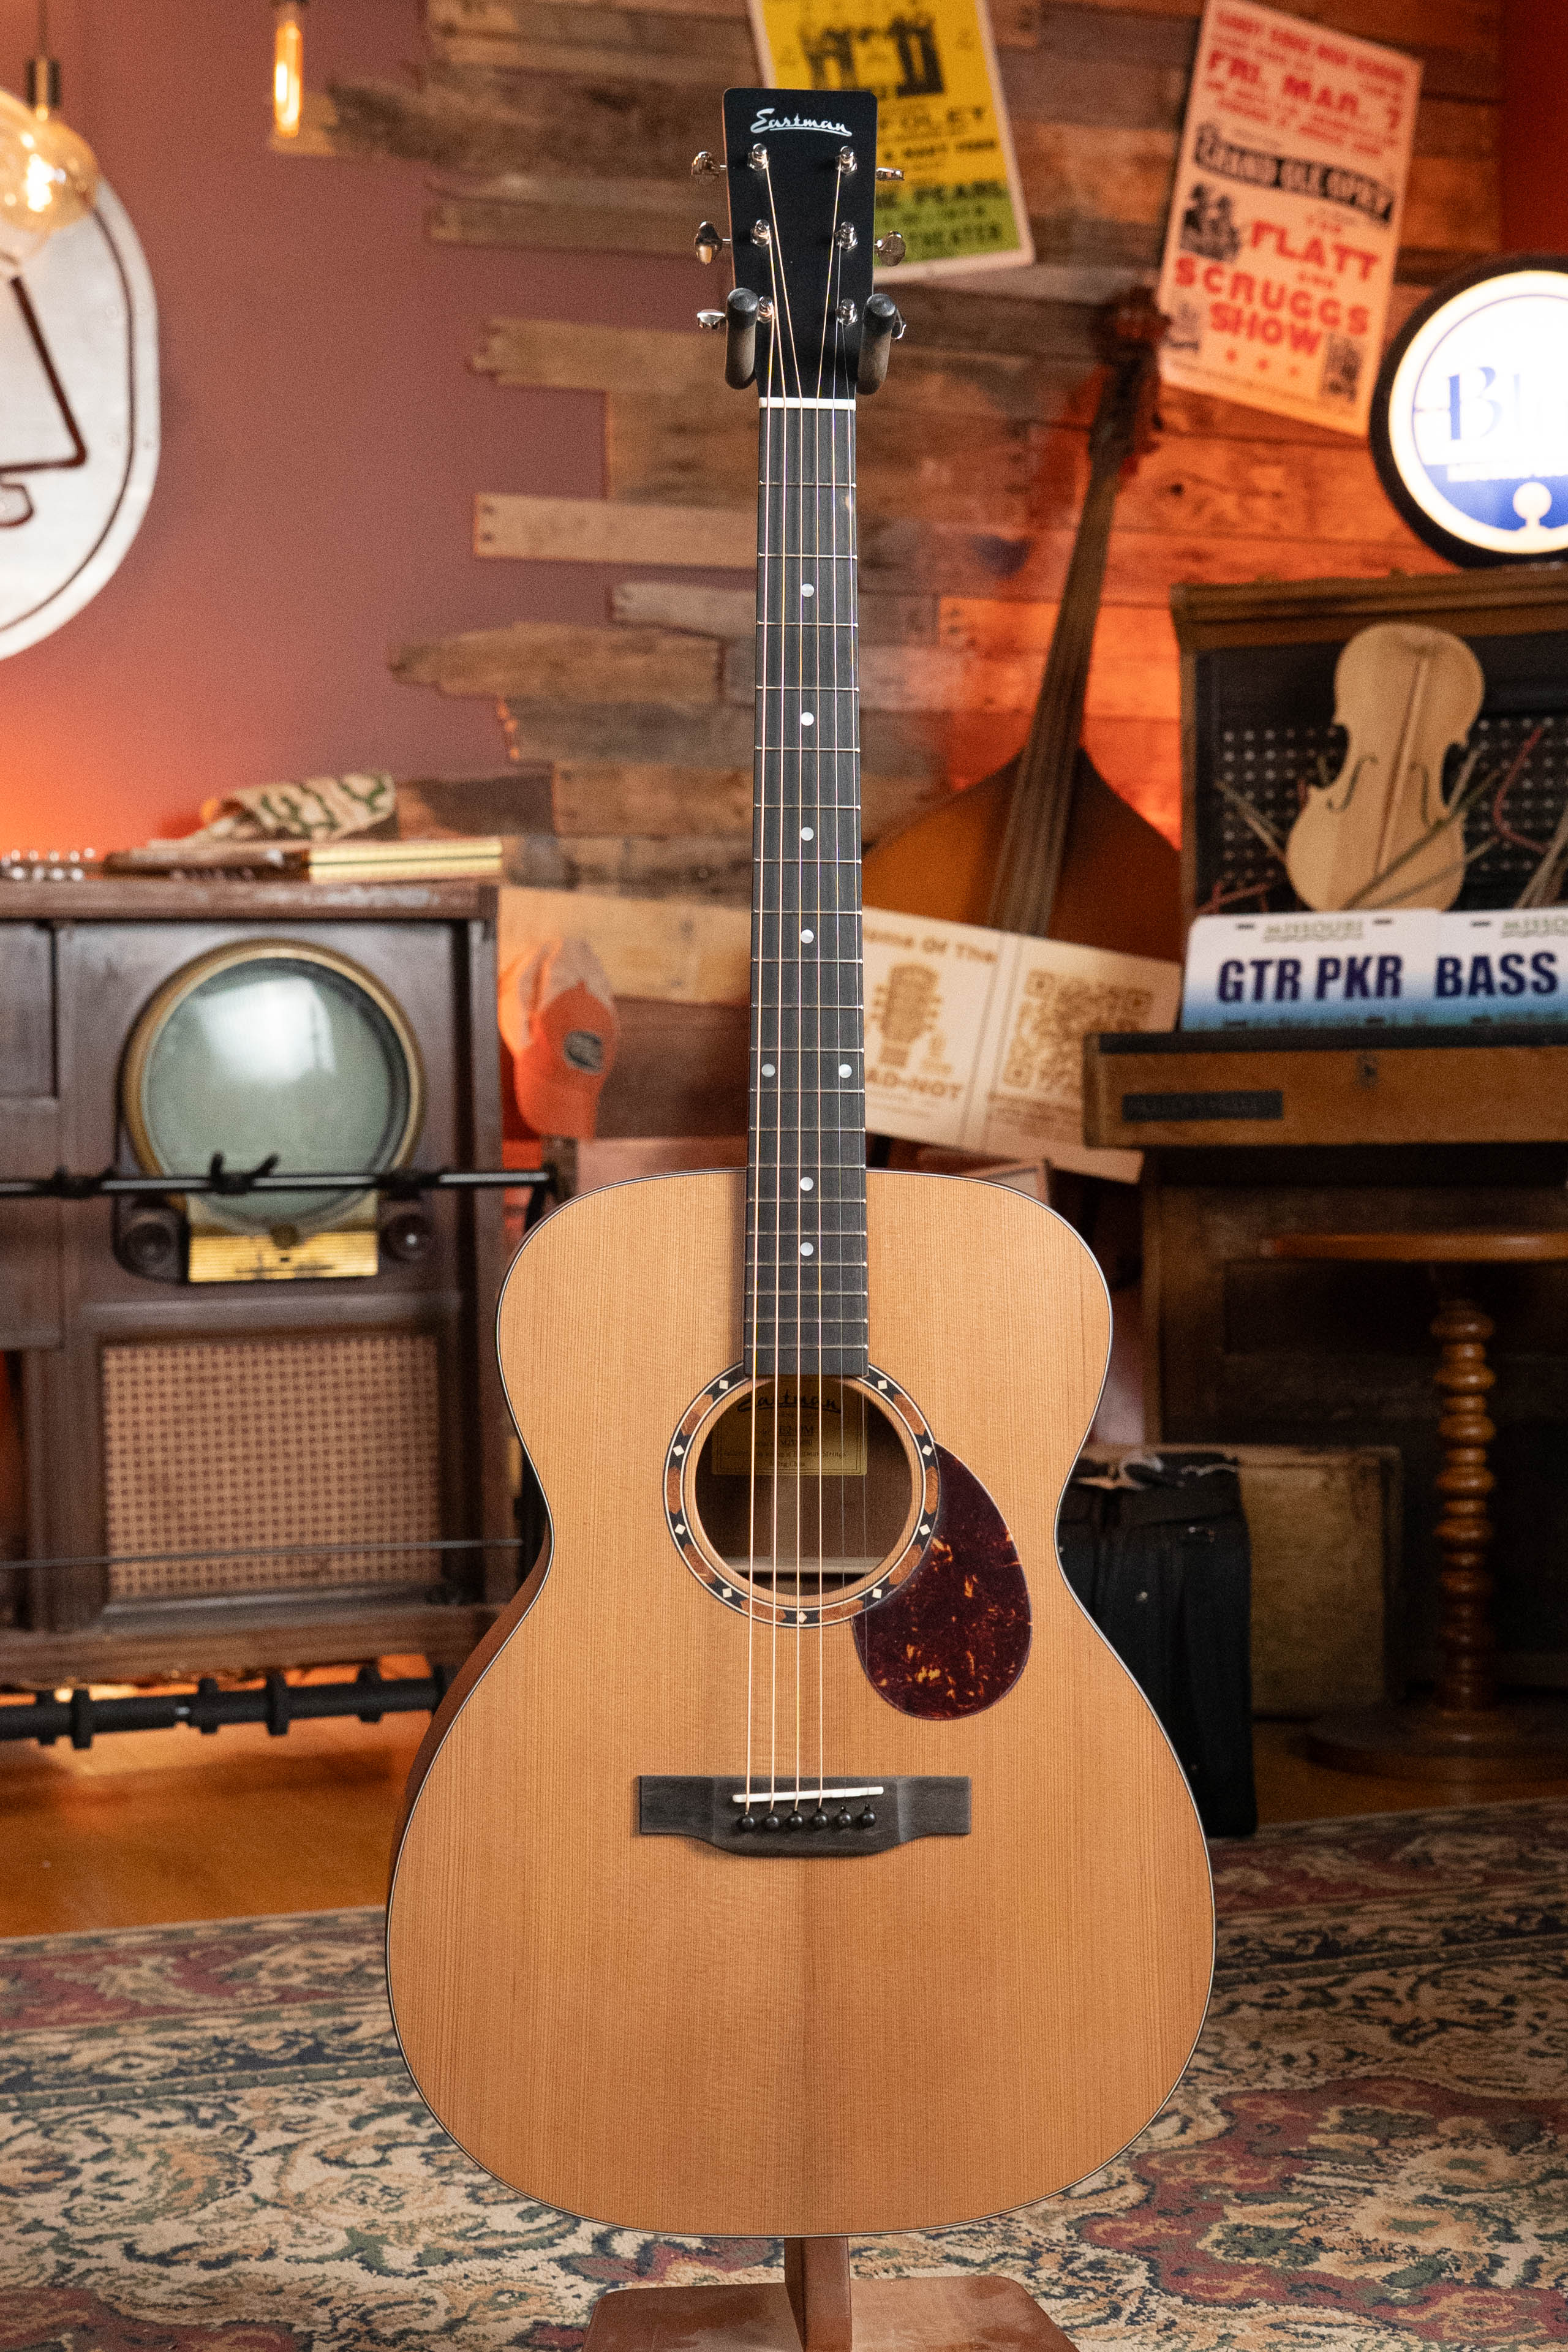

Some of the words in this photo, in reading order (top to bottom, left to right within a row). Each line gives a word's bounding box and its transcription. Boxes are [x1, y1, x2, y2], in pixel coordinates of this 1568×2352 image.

[750, 108, 853, 137] Eastman
[1250, 219, 1380, 281] FLATT
[1174, 256, 1370, 336] SCRUGGS
[1208, 301, 1323, 356] SHOW
[1216, 957, 1303, 1003] GTR
[1314, 954, 1403, 1002] PKR
[1436, 951, 1559, 1000] BASS
